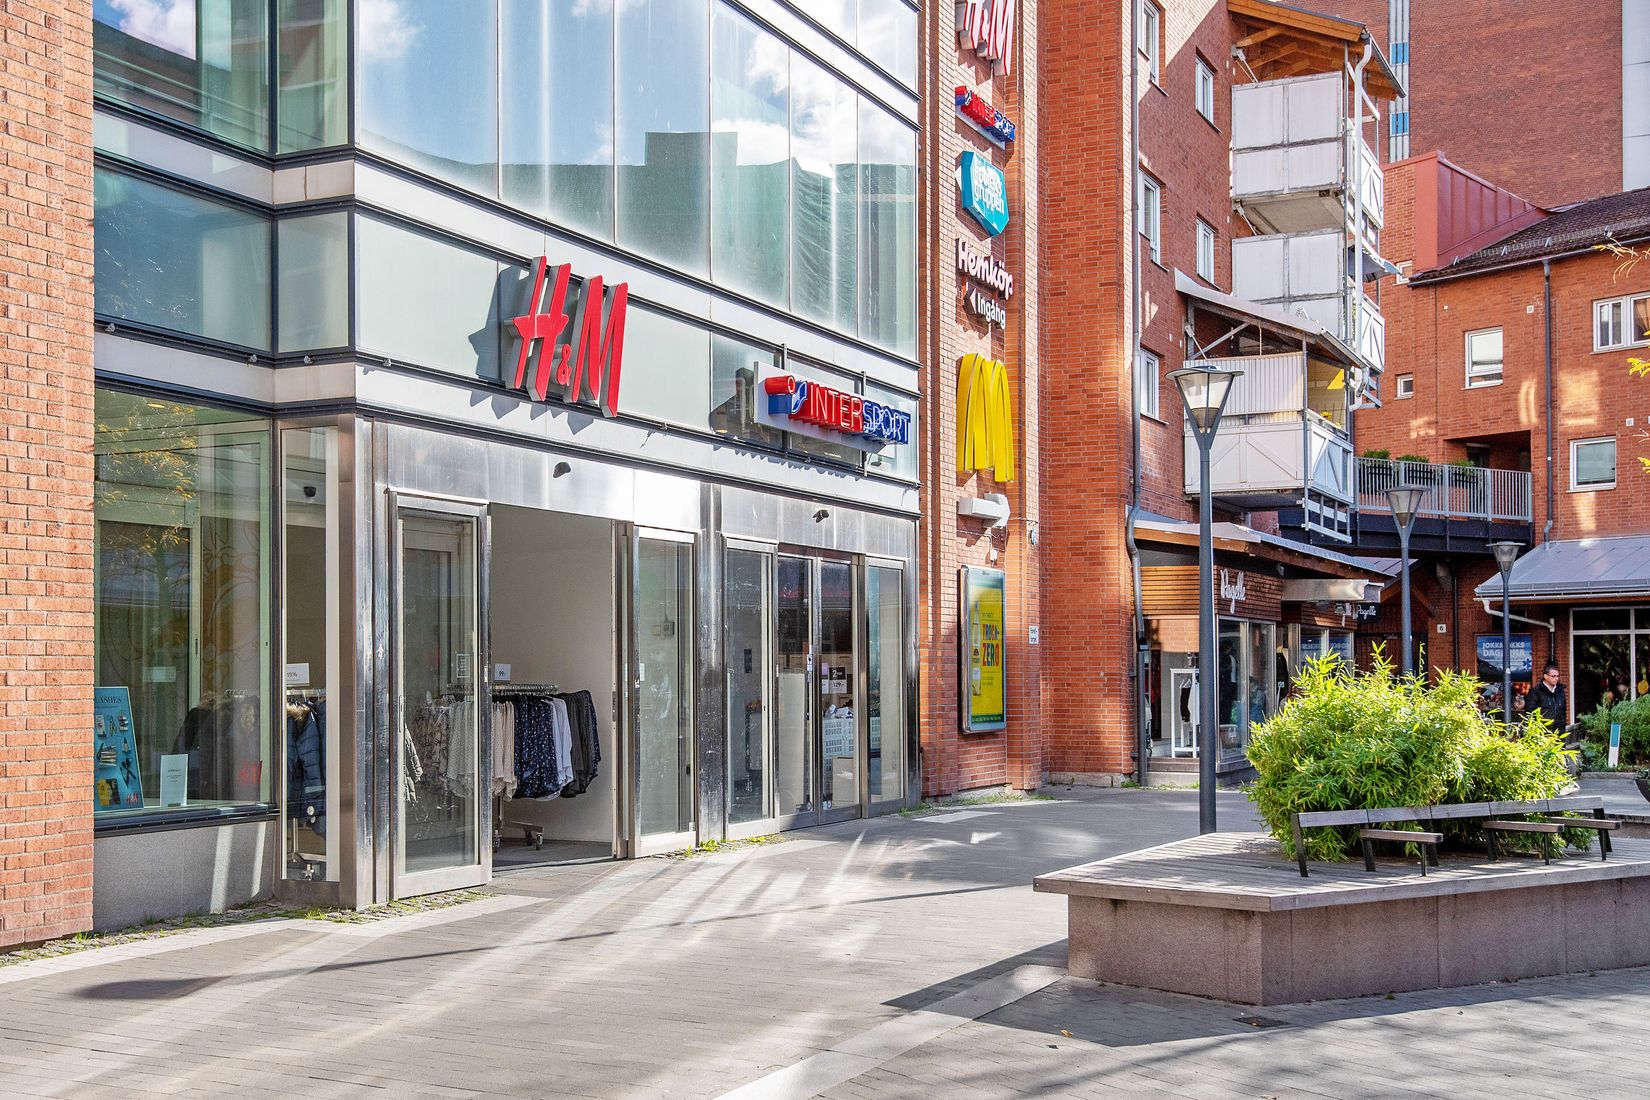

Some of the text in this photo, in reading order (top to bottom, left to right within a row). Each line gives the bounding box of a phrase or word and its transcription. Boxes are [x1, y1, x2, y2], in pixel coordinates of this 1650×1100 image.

[957, 237, 1013, 300] Hemköp
[977, 291, 1005, 329] Ingång
[504, 256, 628, 418] H&M
[801, 382, 911, 445] INTERSPORT
[982, 643, 1000, 666] ZERO
[1482, 641, 1525, 649] JOKKKKS
[1482, 649, 1525, 657] DAGNA
